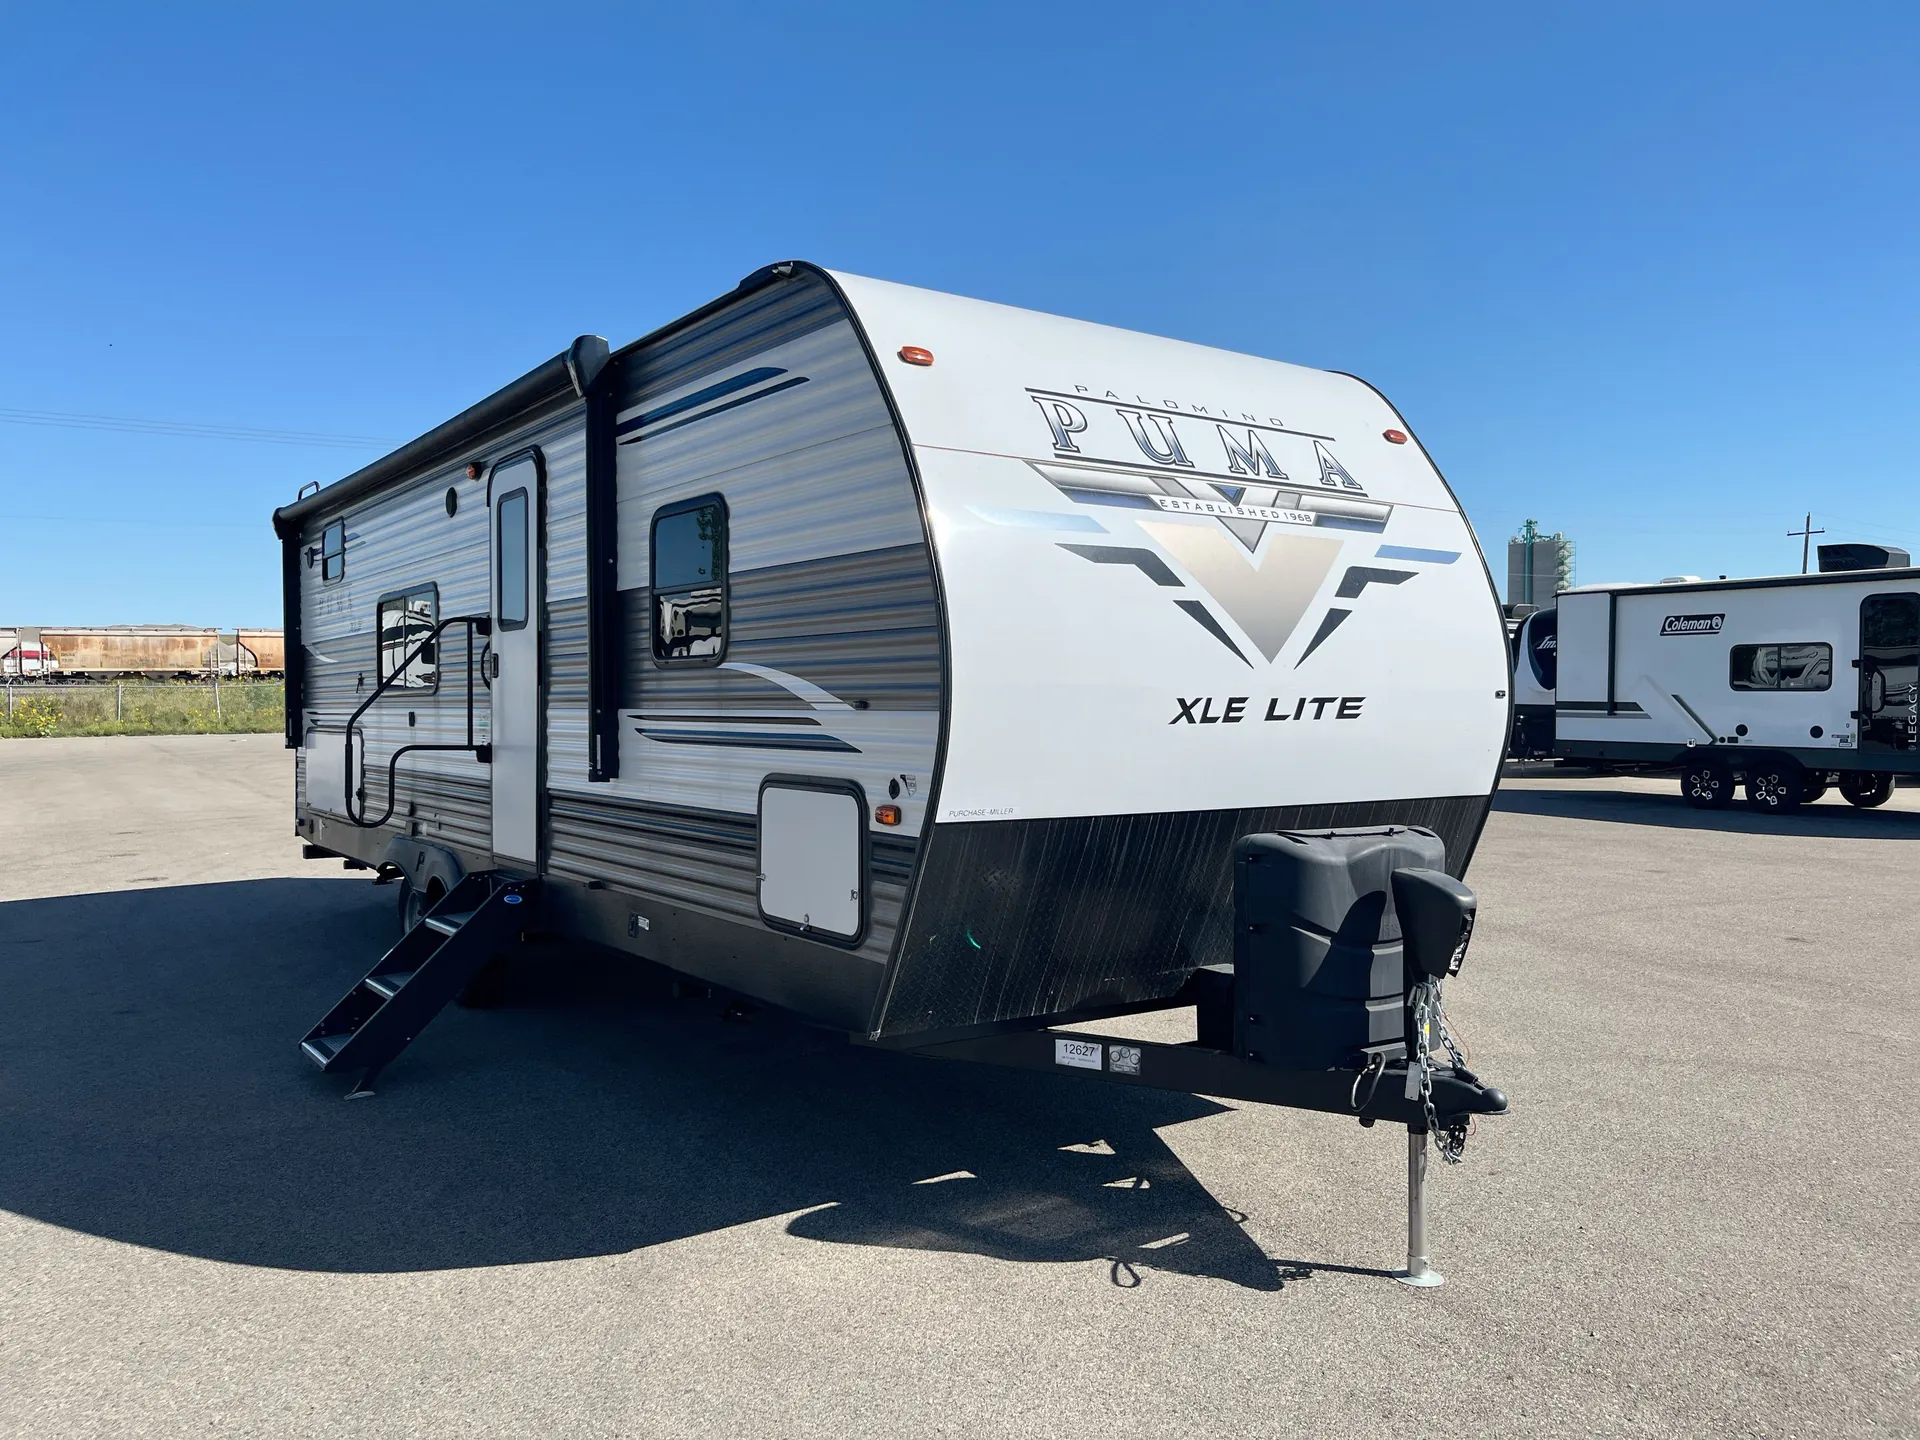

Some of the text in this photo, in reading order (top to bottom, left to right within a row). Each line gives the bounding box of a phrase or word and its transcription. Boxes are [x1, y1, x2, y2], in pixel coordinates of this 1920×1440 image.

[1074, 384, 1284, 427] PALOMINO
[1032, 395, 1364, 491] PUMA
[1159, 499, 1313, 523] ESTABLISHED 1968
[1664, 616, 1711, 632] Coleman
[1167, 696, 1367, 725] XLE LITE
[1907, 684, 1918, 743] LEGACY
[948, 807, 1014, 818] PURCHASE-MILLER
[1063, 1043, 1096, 1058] 12627
